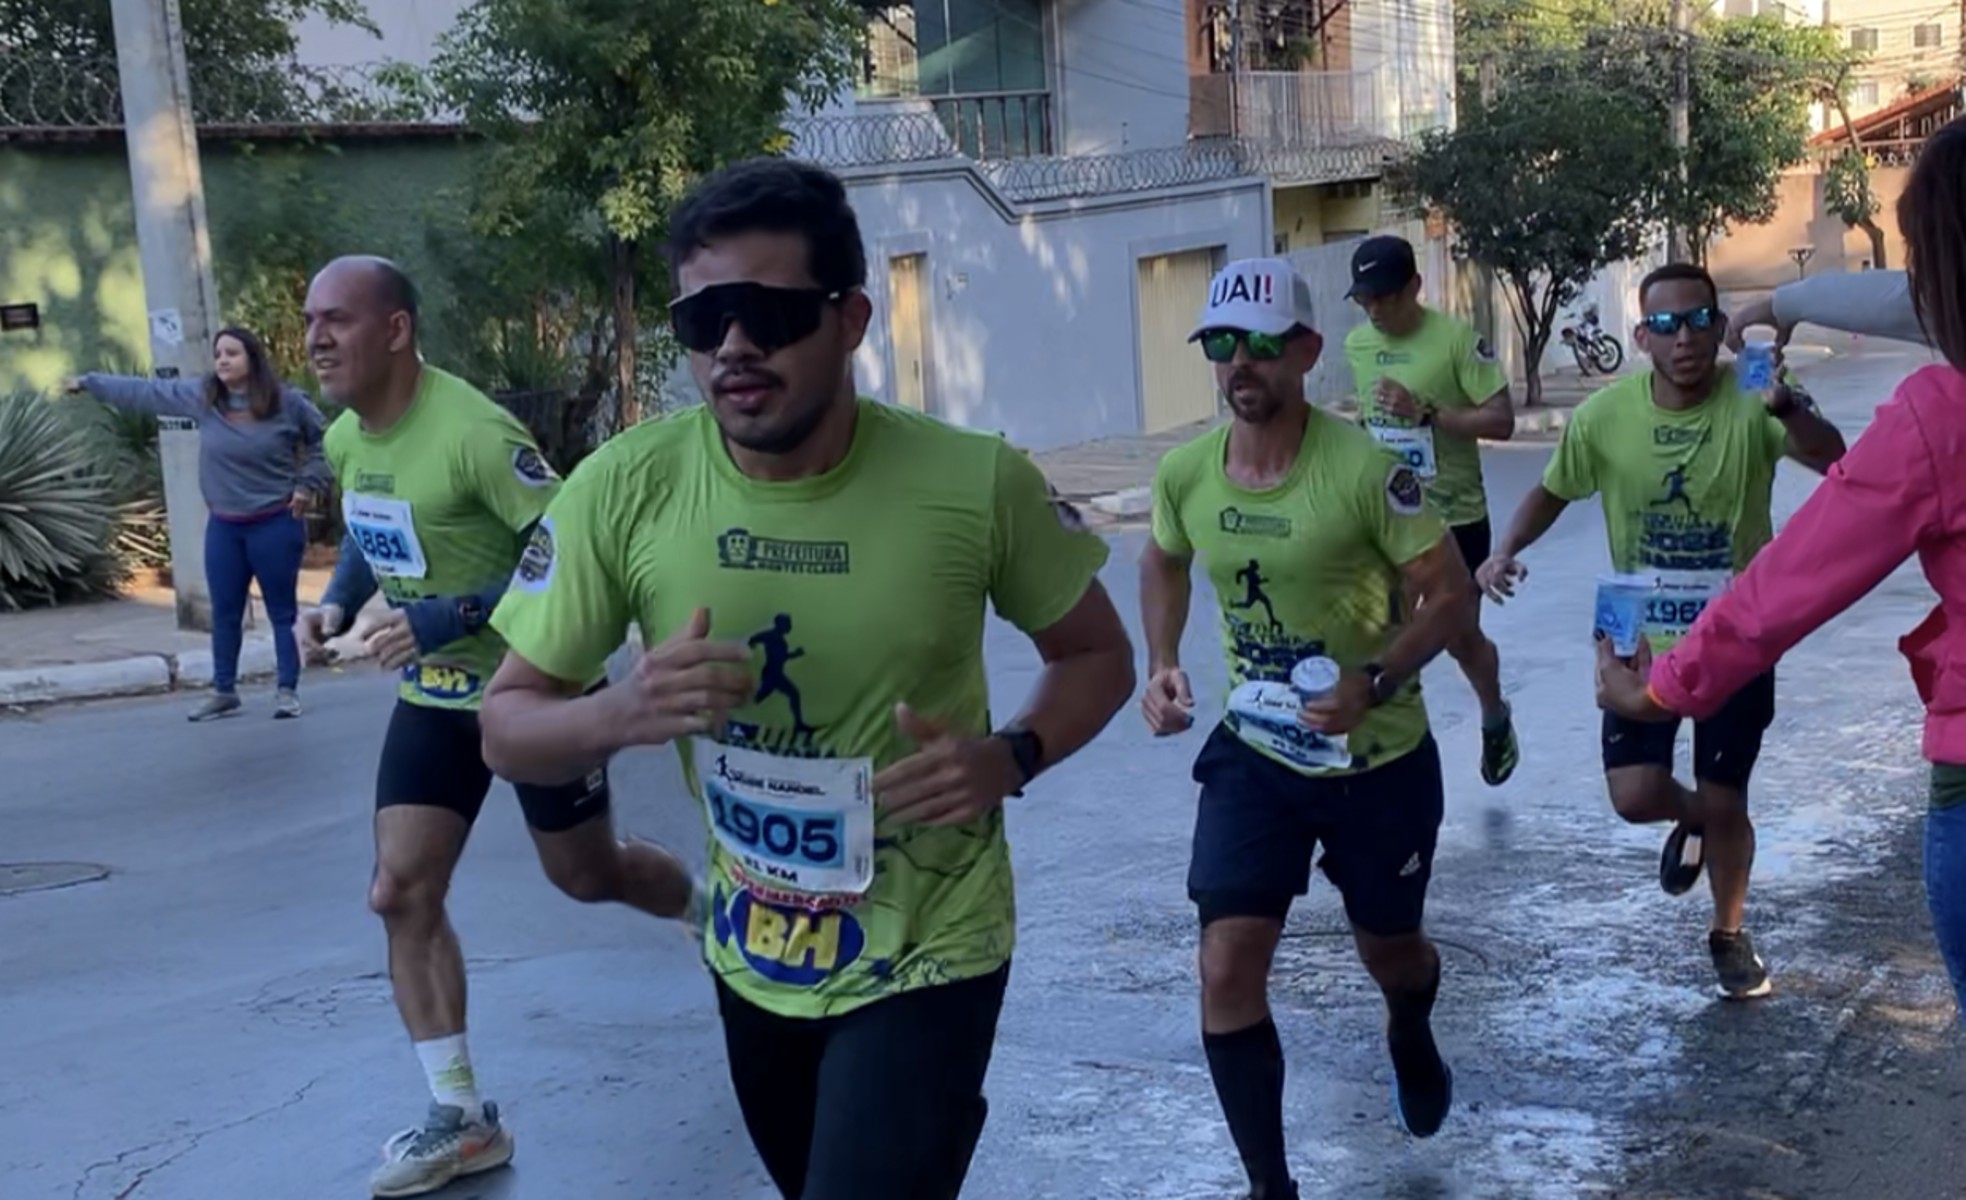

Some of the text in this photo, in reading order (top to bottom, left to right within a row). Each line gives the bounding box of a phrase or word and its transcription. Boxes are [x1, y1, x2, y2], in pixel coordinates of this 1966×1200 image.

[1212, 274, 1273, 308] UAI!
[1645, 601, 1710, 625] 196
[711, 793, 839, 862] 1905
[745, 901, 842, 969] BH
